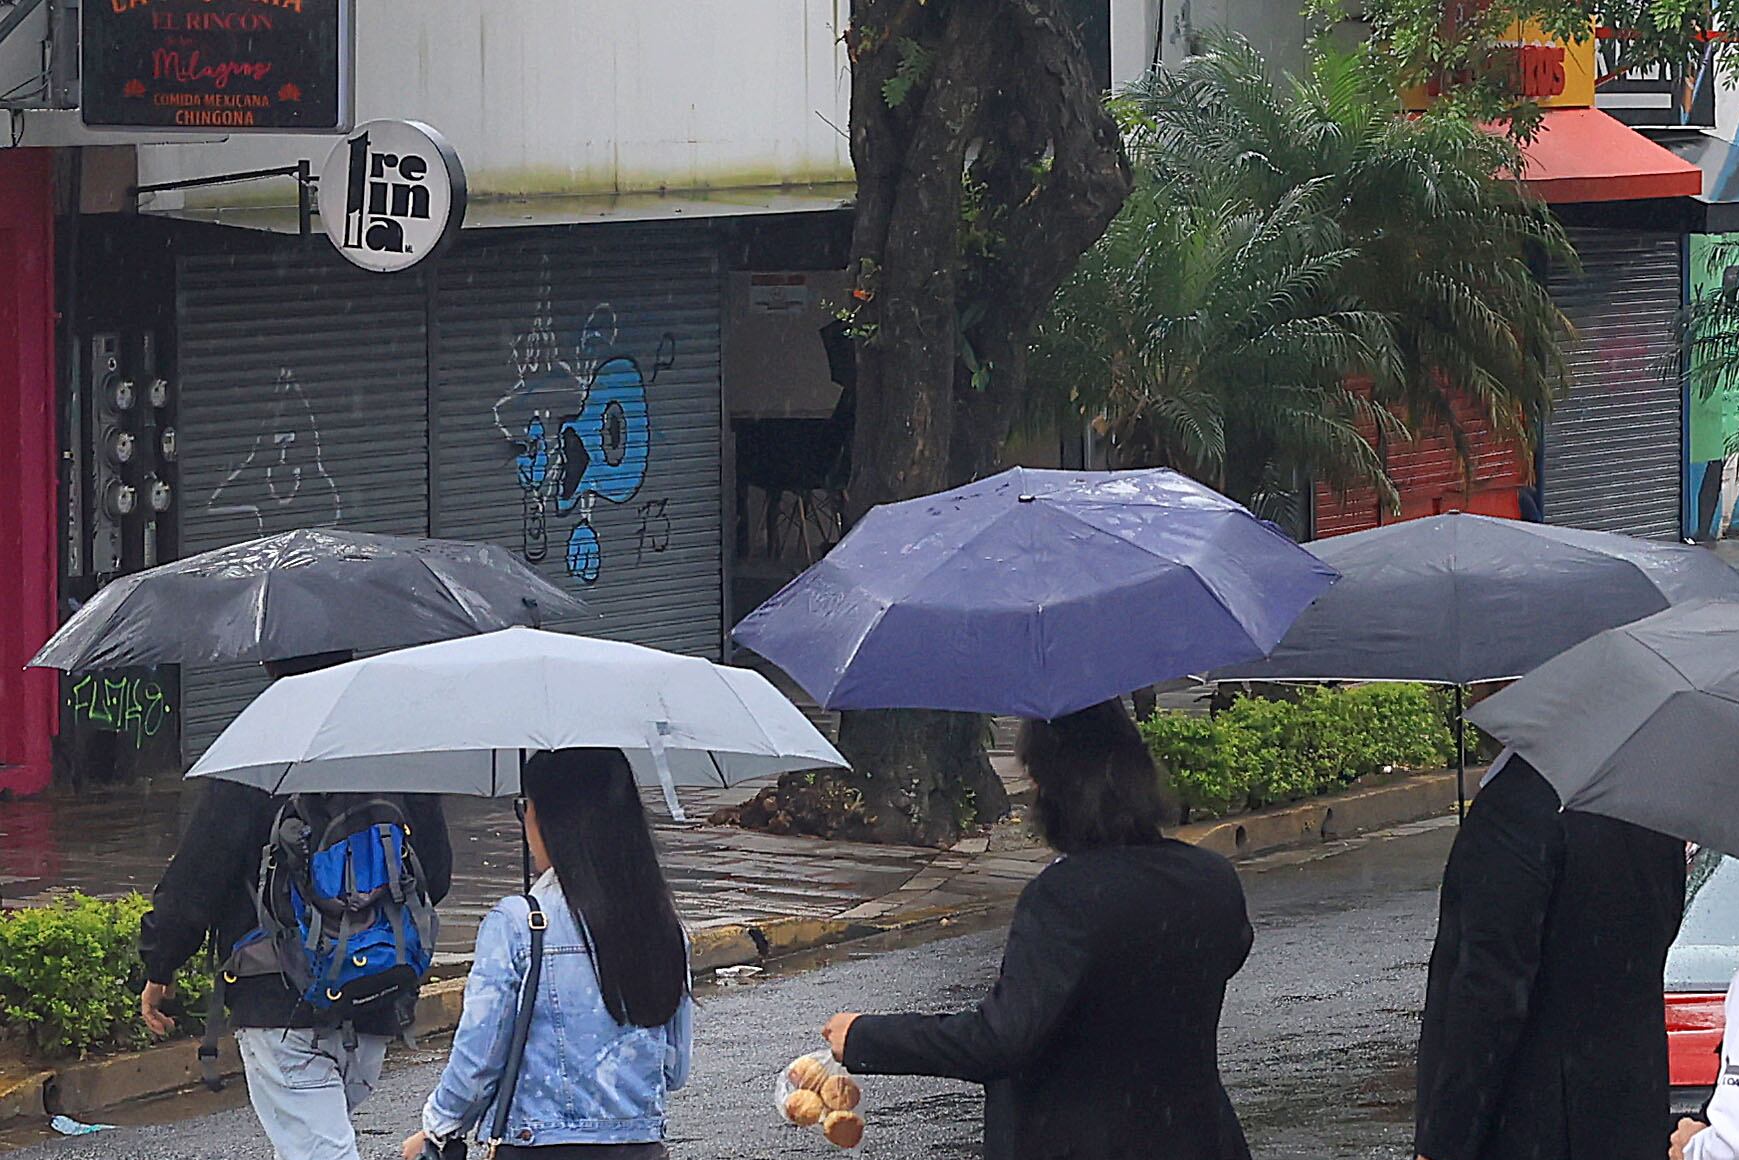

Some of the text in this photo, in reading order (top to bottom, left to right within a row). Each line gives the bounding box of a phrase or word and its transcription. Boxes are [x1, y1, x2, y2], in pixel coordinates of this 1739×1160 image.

[153, 12, 179, 30] EL
[152, 48, 272, 88] Milagros
[154, 94, 271, 106] COMIDA MEXICANA
[176, 110, 254, 125] CHINGONA
